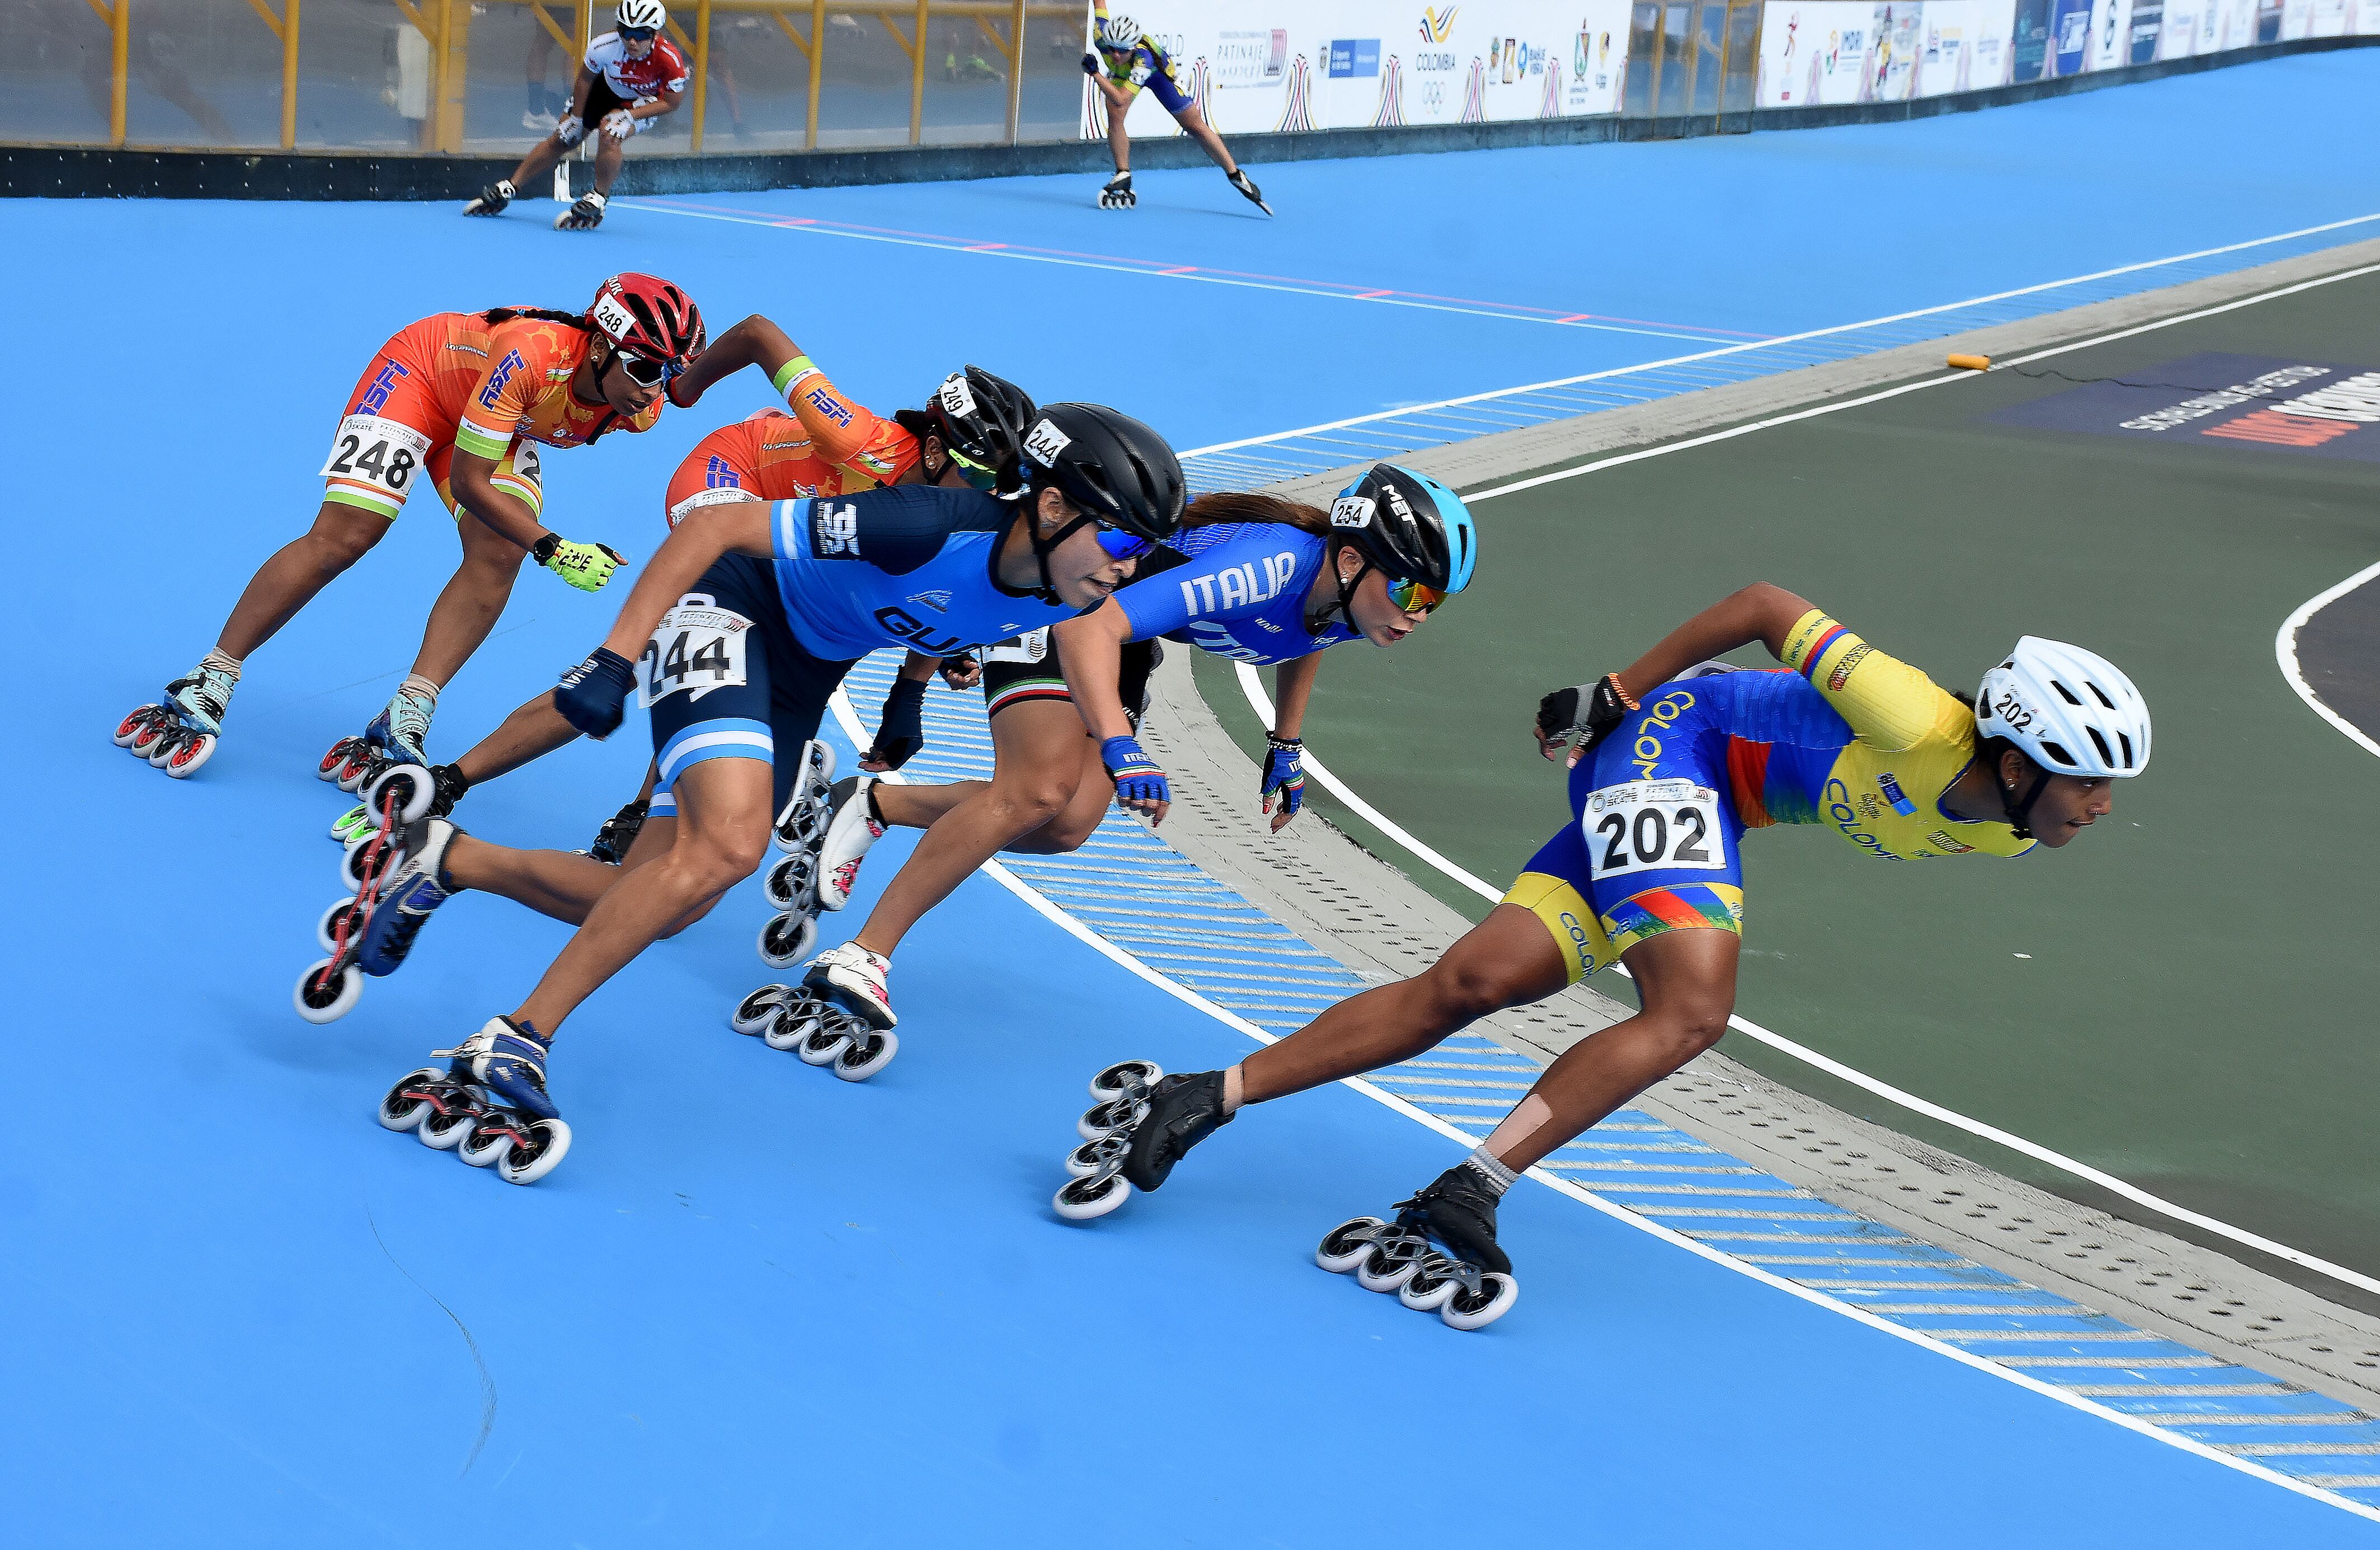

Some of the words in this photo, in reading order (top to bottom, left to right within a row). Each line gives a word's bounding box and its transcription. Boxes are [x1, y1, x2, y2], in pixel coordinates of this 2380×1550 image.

[598, 306, 623, 333] 248
[942, 386, 963, 412] 249
[330, 435, 415, 490] 248
[1027, 429, 1059, 462] 244
[1334, 505, 1362, 525] 254
[1180, 552, 1296, 616] ITALIA
[639, 631, 731, 698] 244
[1995, 693, 2032, 734] 202
[1595, 807, 1710, 871] 202
